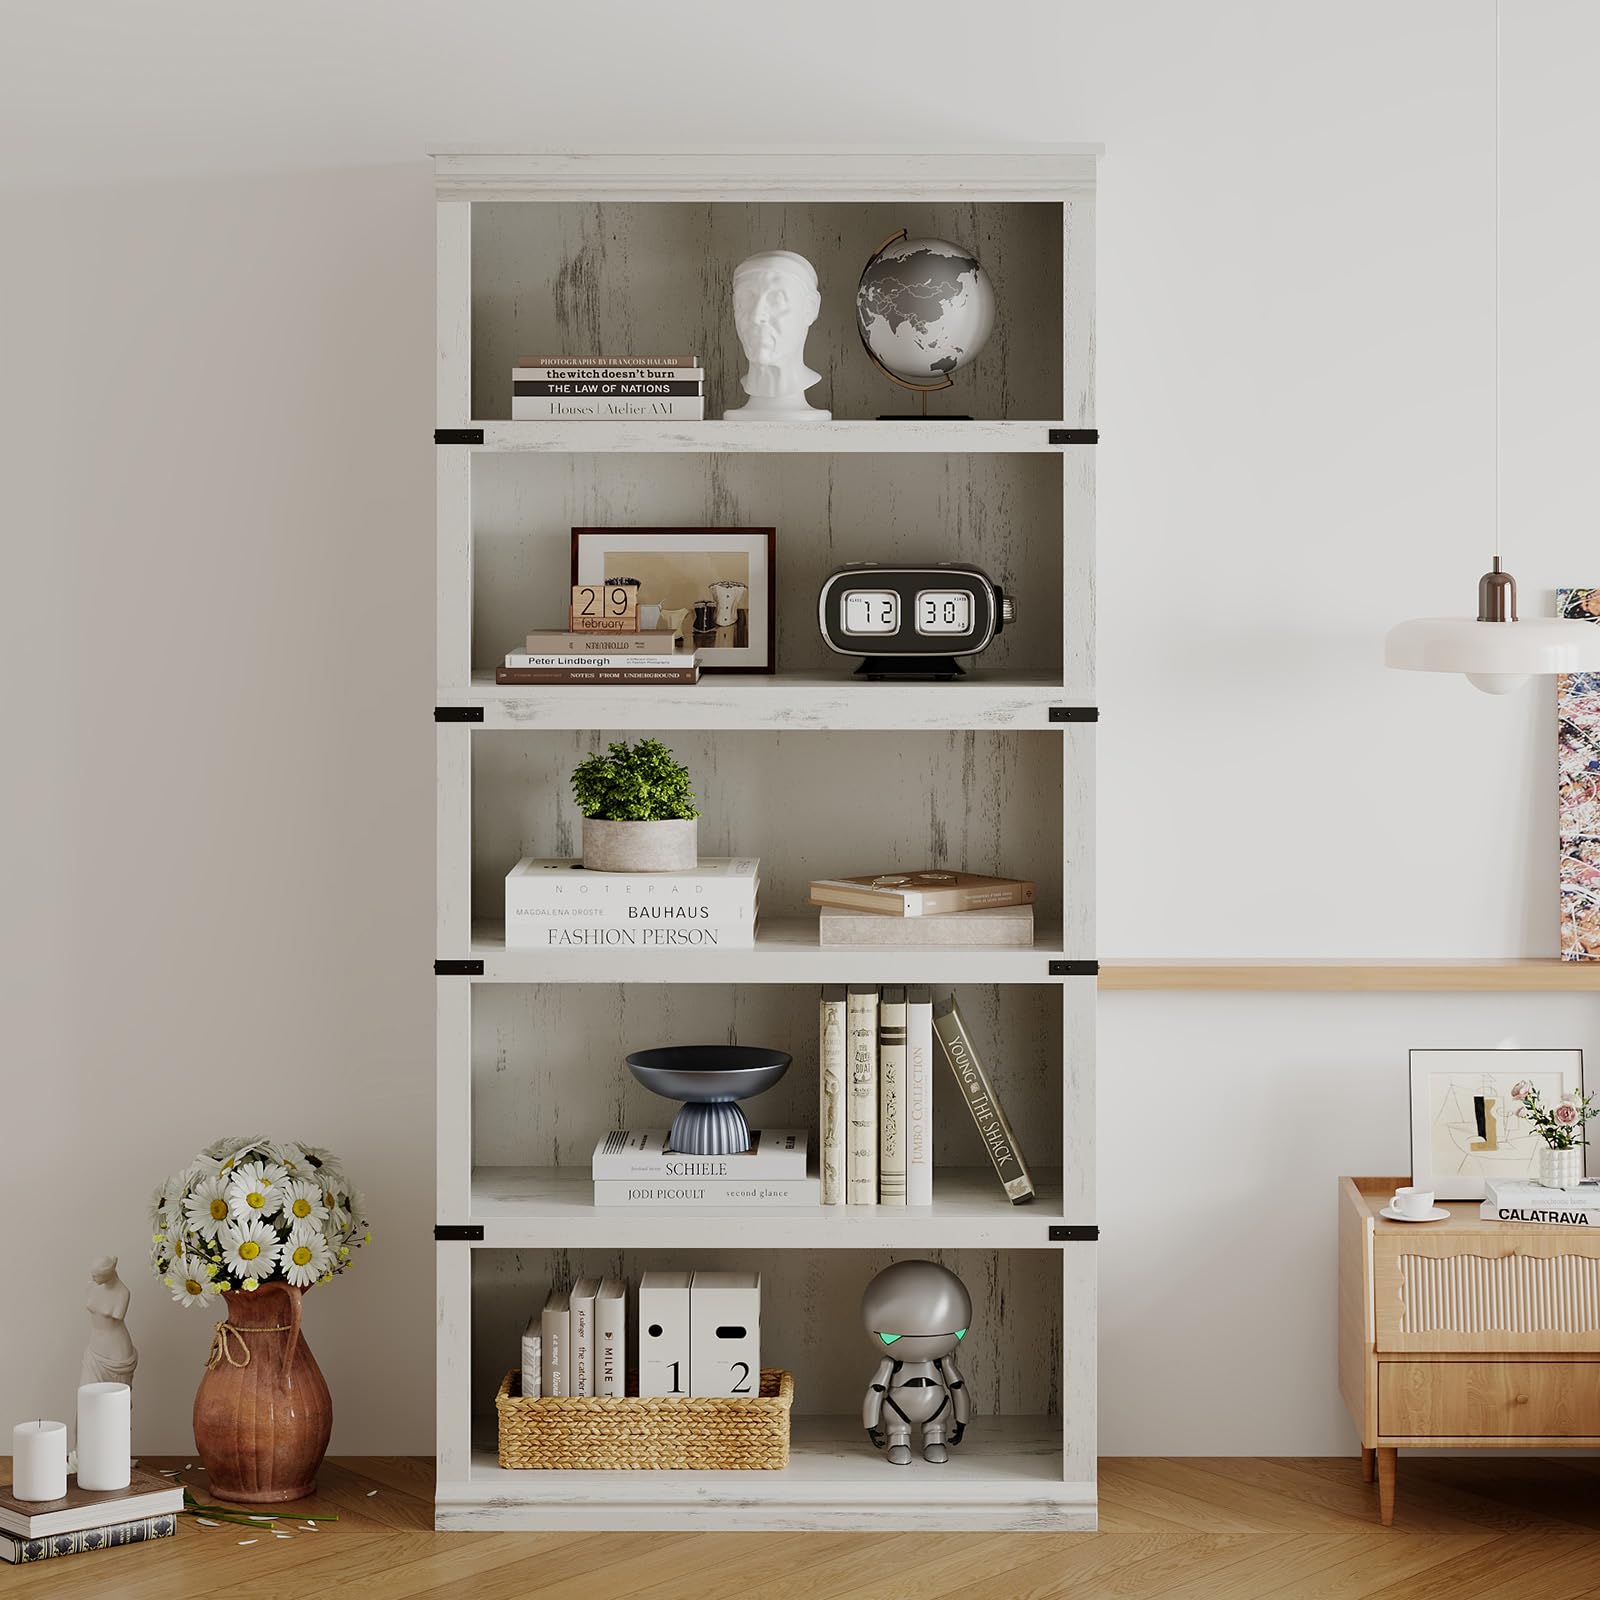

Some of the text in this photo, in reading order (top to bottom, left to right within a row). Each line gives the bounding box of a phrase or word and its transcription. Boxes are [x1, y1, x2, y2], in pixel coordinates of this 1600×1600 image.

[546, 369, 566, 379] the
[567, 369, 600, 379] witch
[647, 369, 675, 379] burn
[547, 384, 671, 393] THE LAW OF NATIONS
[550, 402, 673, 415] Houses Atelier AM
[864, 601, 893, 624] 12
[925, 601, 955, 624] 30
[581, 618, 625, 630] february
[528, 656, 611, 667] Peter Lindbergh
[516, 908, 604, 916] MAGDALENA DROSTE
[628, 906, 710, 919] BAUHAUS
[548, 928, 719, 945] FASHION PERSON
[911, 1046, 925, 1165] JUMBO COLLECTION
[948, 1035, 1014, 1168] YOUNG THE SHACK
[665, 1162, 728, 1176] SCHIELE
[628, 1189, 706, 1200] JODI PICOULT
[726, 1189, 789, 1199] second glance
[1499, 1208, 1589, 1225] CALATRAVA
[578, 1347, 587, 1360] the
[604, 1347, 614, 1382] MILNE
[578, 1361, 587, 1392] catcher
[666, 1361, 686, 1393] 1
[729, 1361, 752, 1393] 2
